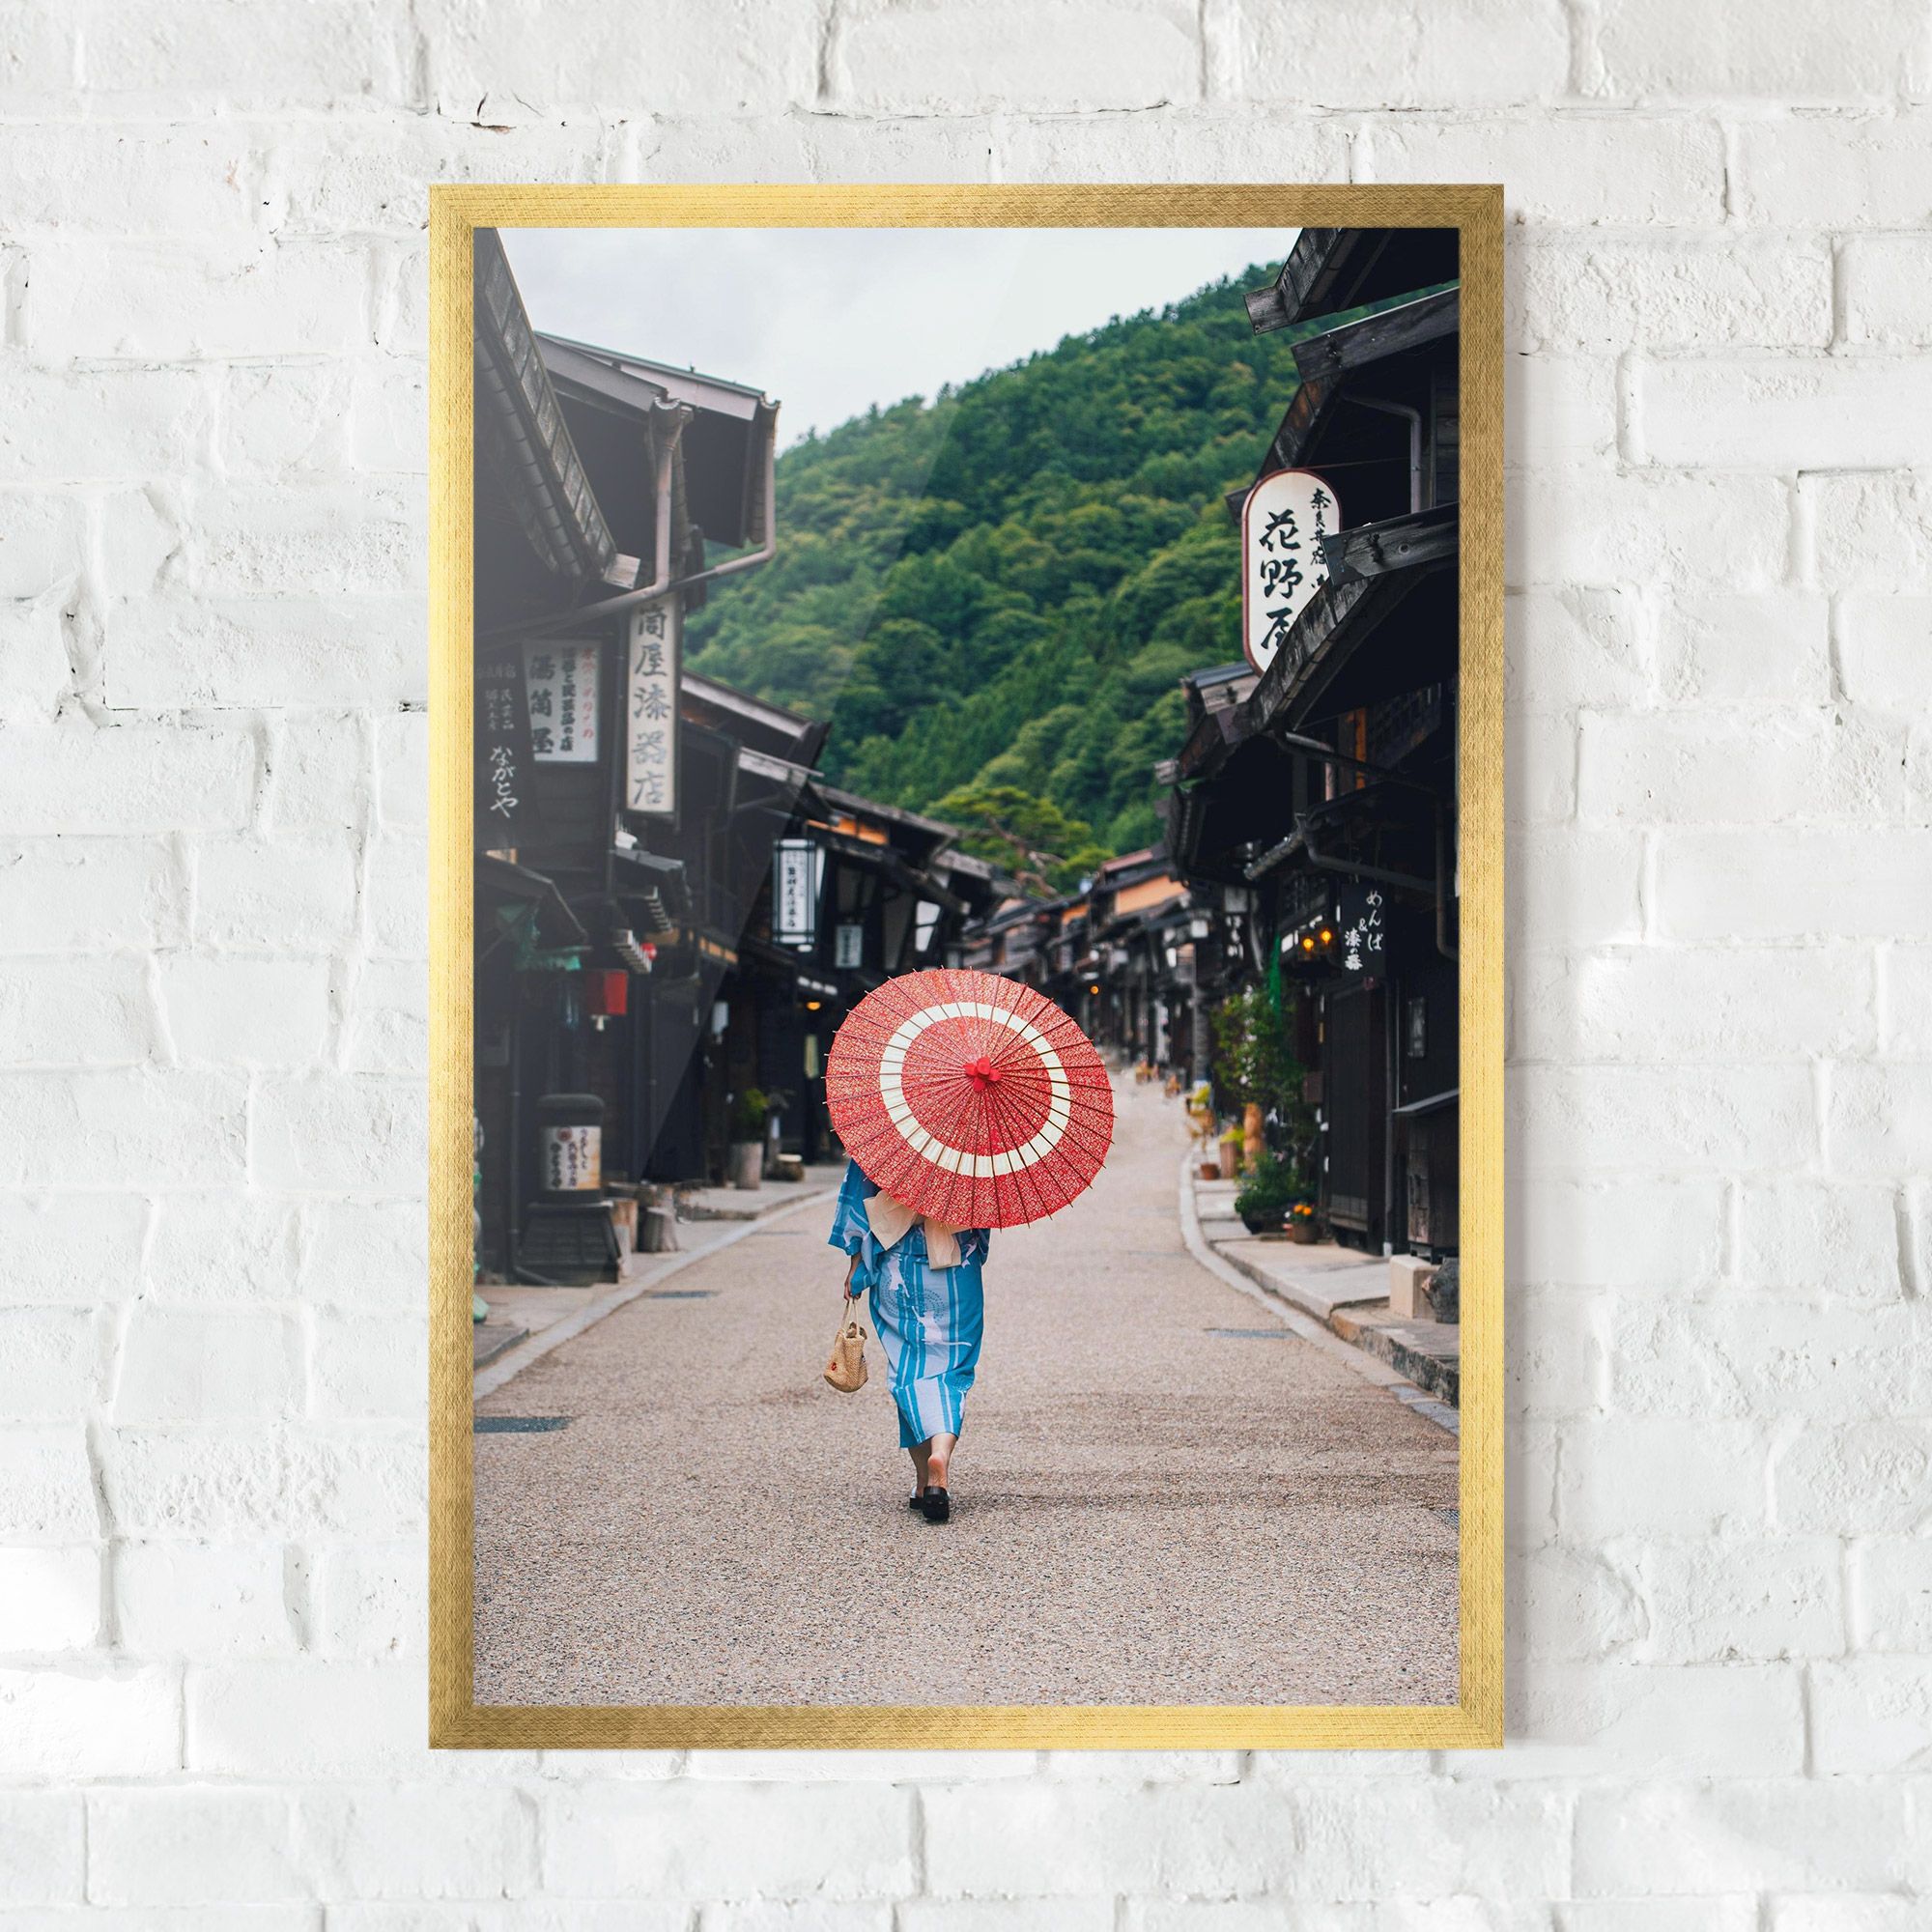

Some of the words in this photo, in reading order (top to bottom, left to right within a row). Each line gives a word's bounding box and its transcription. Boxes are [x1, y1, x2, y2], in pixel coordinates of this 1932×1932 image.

[633, 604, 671, 805] 筒屋漆器店
[490, 745, 520, 819] ながとや
[1358, 918, 1368, 931] &
